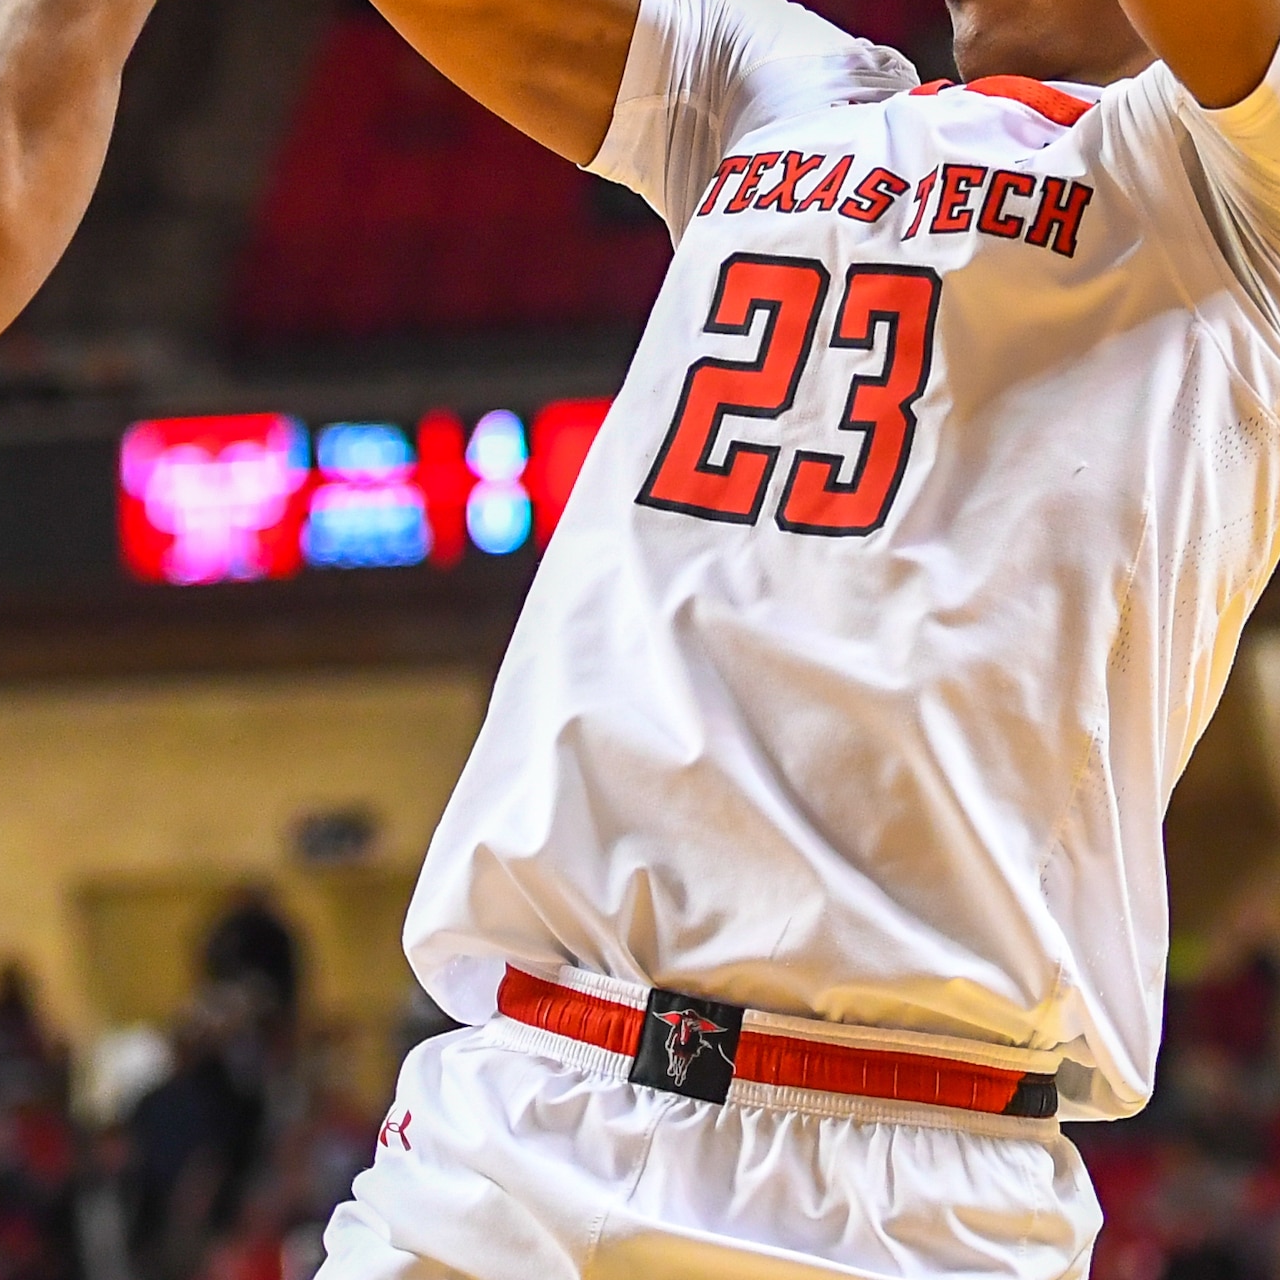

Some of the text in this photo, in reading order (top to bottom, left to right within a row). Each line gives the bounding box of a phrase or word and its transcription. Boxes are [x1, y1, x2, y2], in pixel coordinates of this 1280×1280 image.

[697, 151, 1093, 258] TEXAS TECH
[635, 252, 942, 537] 23
